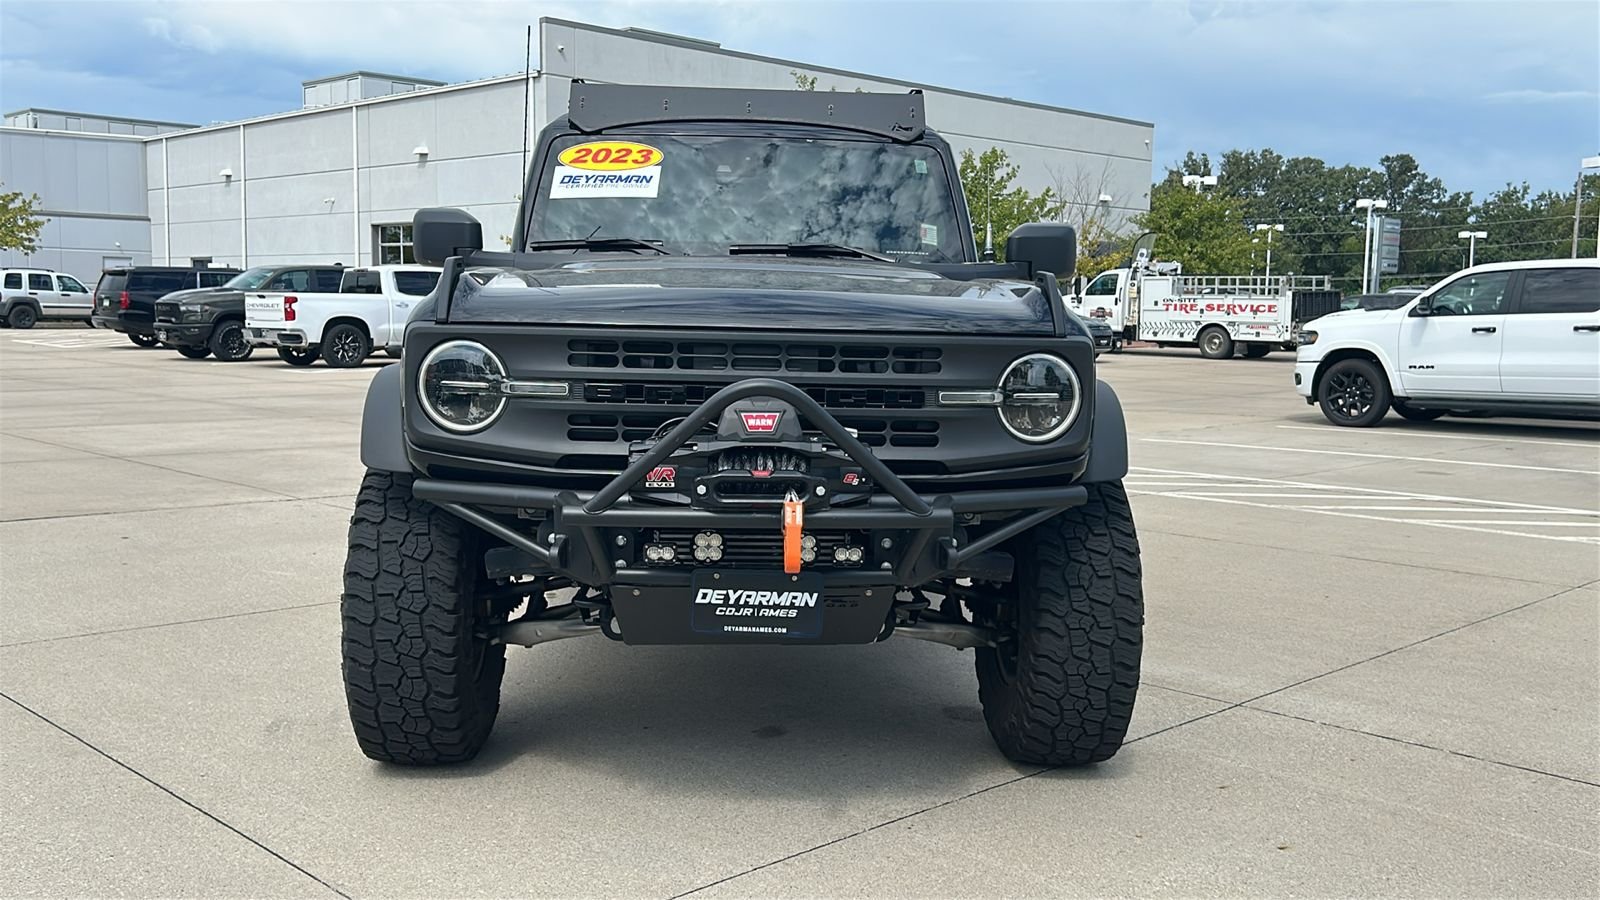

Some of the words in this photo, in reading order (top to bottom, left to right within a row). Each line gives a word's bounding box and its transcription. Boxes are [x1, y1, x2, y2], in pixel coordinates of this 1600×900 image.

[568, 148, 654, 165] 2023
[559, 174, 654, 185] DEYARMAN
[1162, 303, 1199, 314] TIRE
[1205, 304, 1278, 315] SERVICE
[747, 418, 773, 427] WARN
[695, 588, 819, 608] DEYARMAN
[758, 609, 798, 618] AMES
[723, 625, 788, 634] DEYARMANAMES.COM
